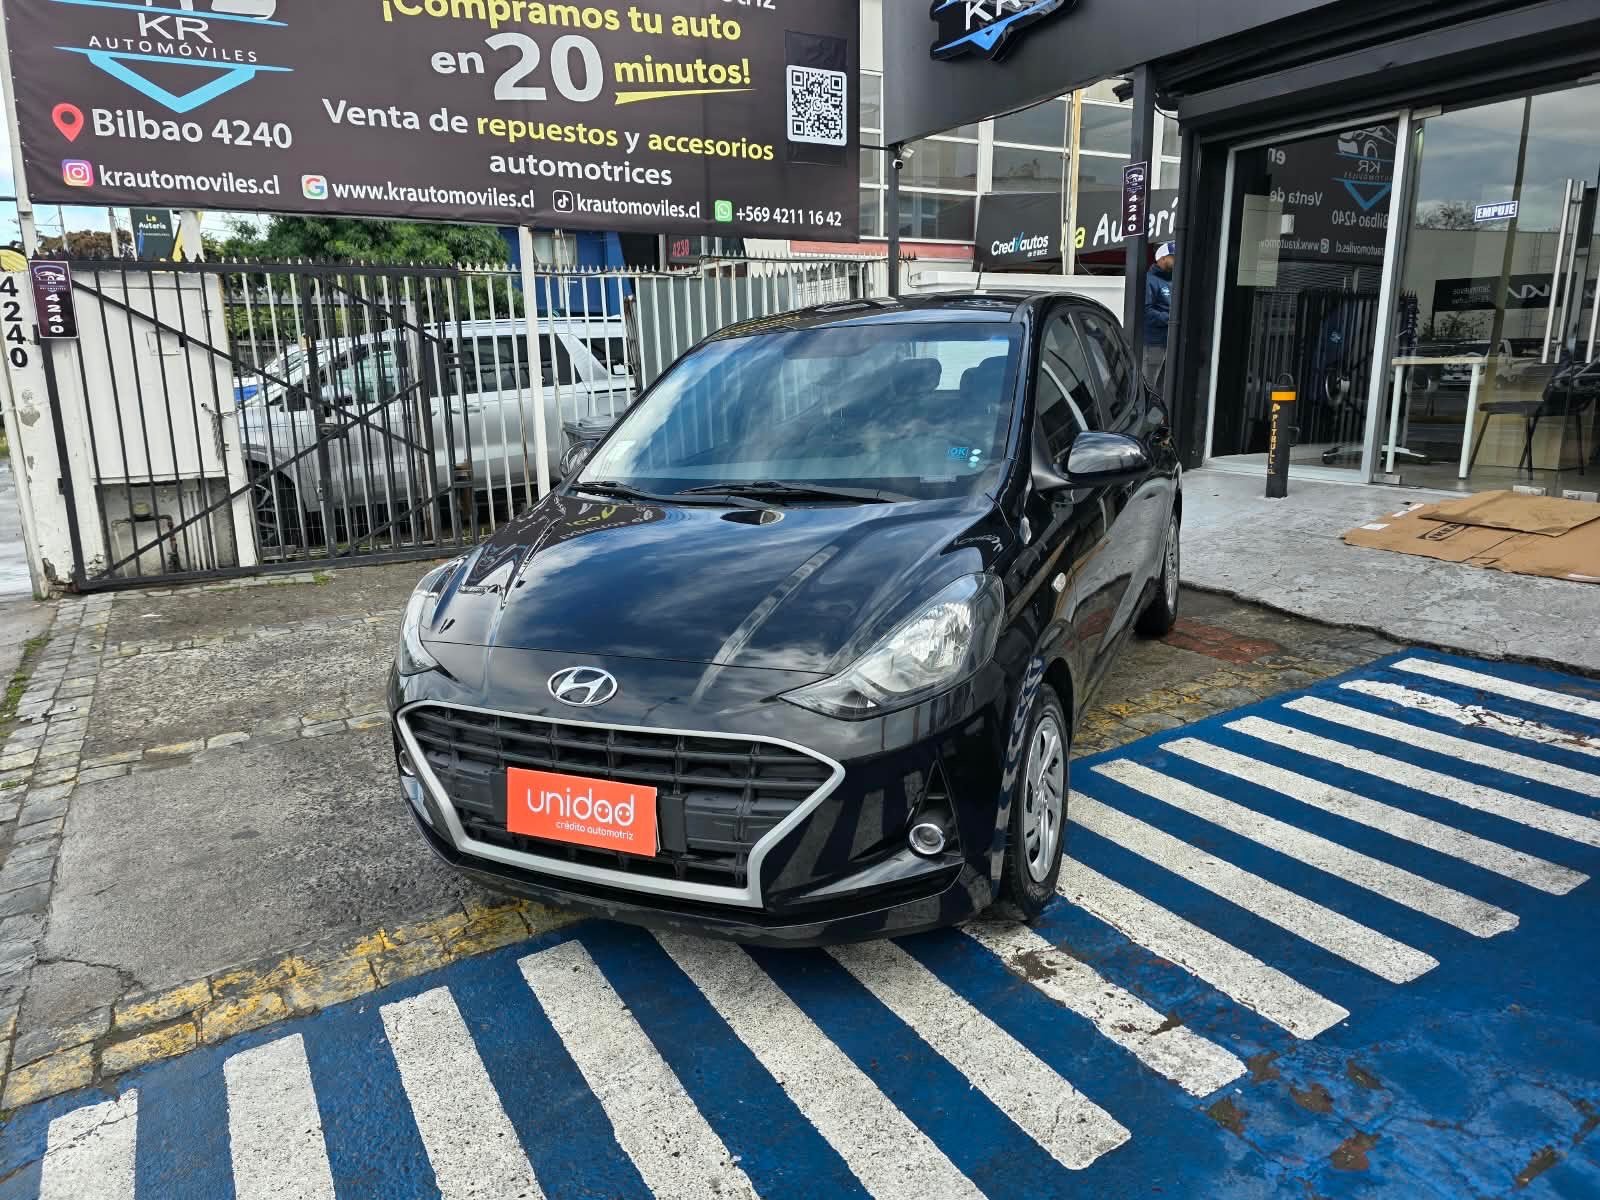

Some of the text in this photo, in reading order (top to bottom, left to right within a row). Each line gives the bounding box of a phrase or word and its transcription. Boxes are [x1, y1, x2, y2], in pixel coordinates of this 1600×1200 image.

[137, 12, 214, 43] KR
[628, 6, 663, 34] tu
[671, 13, 741, 40] auto
[89, 35, 257, 62] AUTOMÓVILES
[431, 32, 751, 102] en 20 minutos!
[92, 108, 293, 149] Bilbao 4240
[322, 98, 774, 160] Venta de repuestos y accesorios
[99, 165, 280, 195] krautomoviles.cl
[489, 154, 673, 185] automotrices
[332, 182, 534, 208] www.krautomoviles.cl
[577, 194, 700, 219] krautomoviles.cl
[1476, 203, 1515, 218] EMPUJE
[736, 206, 842, 226] +569 4211 16 42
[0, 275, 28, 368] 4240
[45, 293, 65, 333] 4240
[527, 787, 635, 827] unidad
[555, 821, 634, 841] crédito automotriz
